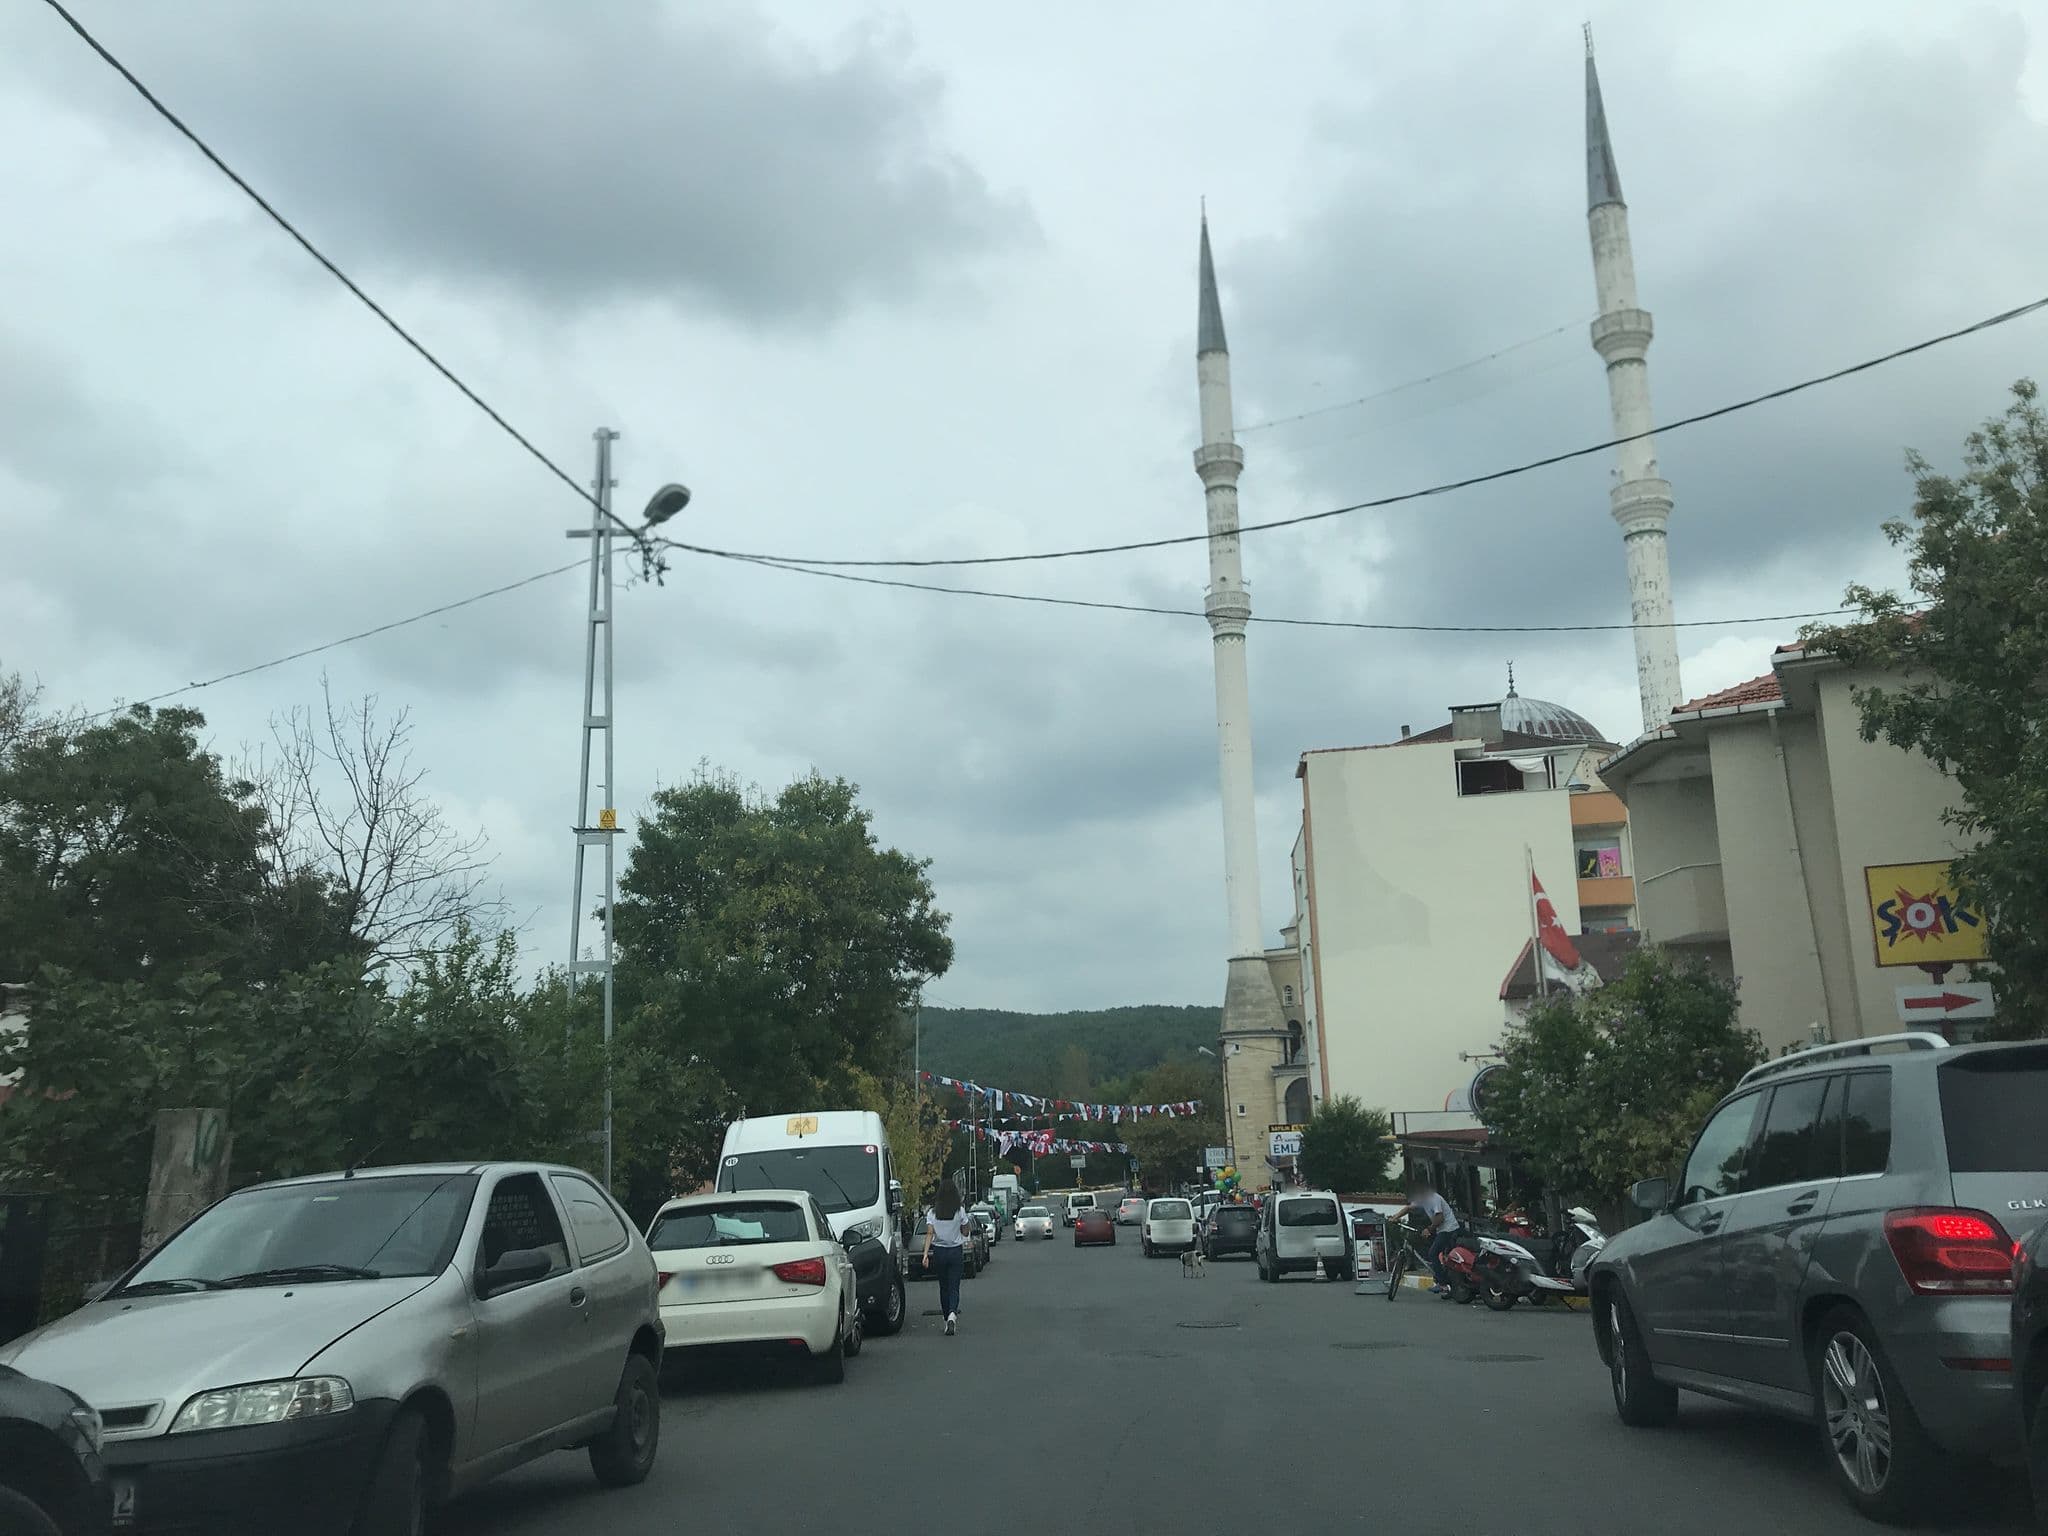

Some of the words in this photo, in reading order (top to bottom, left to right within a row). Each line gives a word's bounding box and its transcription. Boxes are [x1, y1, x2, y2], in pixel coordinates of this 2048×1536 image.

[1877, 894, 1980, 948] ŞOK
[1273, 1142, 1301, 1154] EMLA
[2007, 1198, 2047, 1210] GLK
